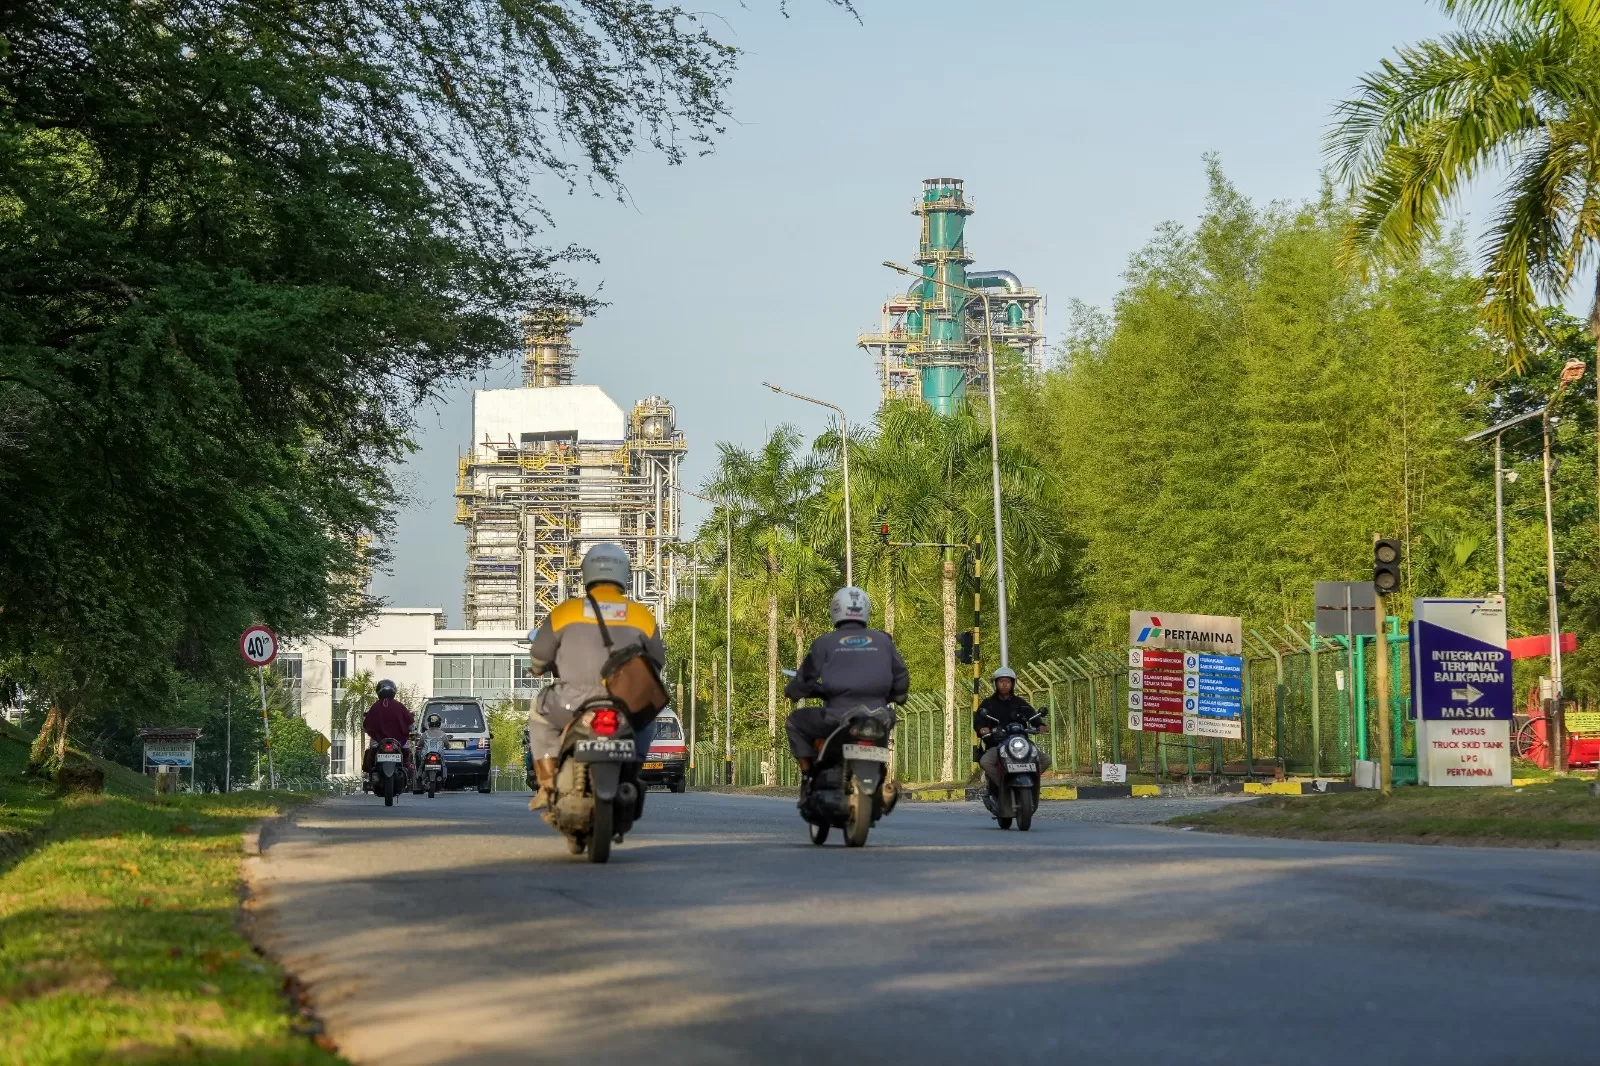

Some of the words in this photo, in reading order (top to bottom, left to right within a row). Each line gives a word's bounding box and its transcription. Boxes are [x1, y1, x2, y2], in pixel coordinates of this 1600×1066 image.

[1164, 628, 1234, 643] PERTAMINA
[248, 637, 263, 658] 40
[1432, 650, 1504, 661] INTEGRATED
[1440, 661, 1498, 672] TERMINAL
[1434, 672, 1504, 683] BALIKPAPAN
[1441, 707, 1496, 718] MASUK
[1451, 728, 1486, 736] KHUSUS
[1433, 741, 1459, 749] TRUCK
[1462, 741, 1480, 749] SKID
[1482, 741, 1504, 749] TANK
[1461, 754, 1478, 763] LPG
[1446, 768, 1493, 777] PERTAMINA
